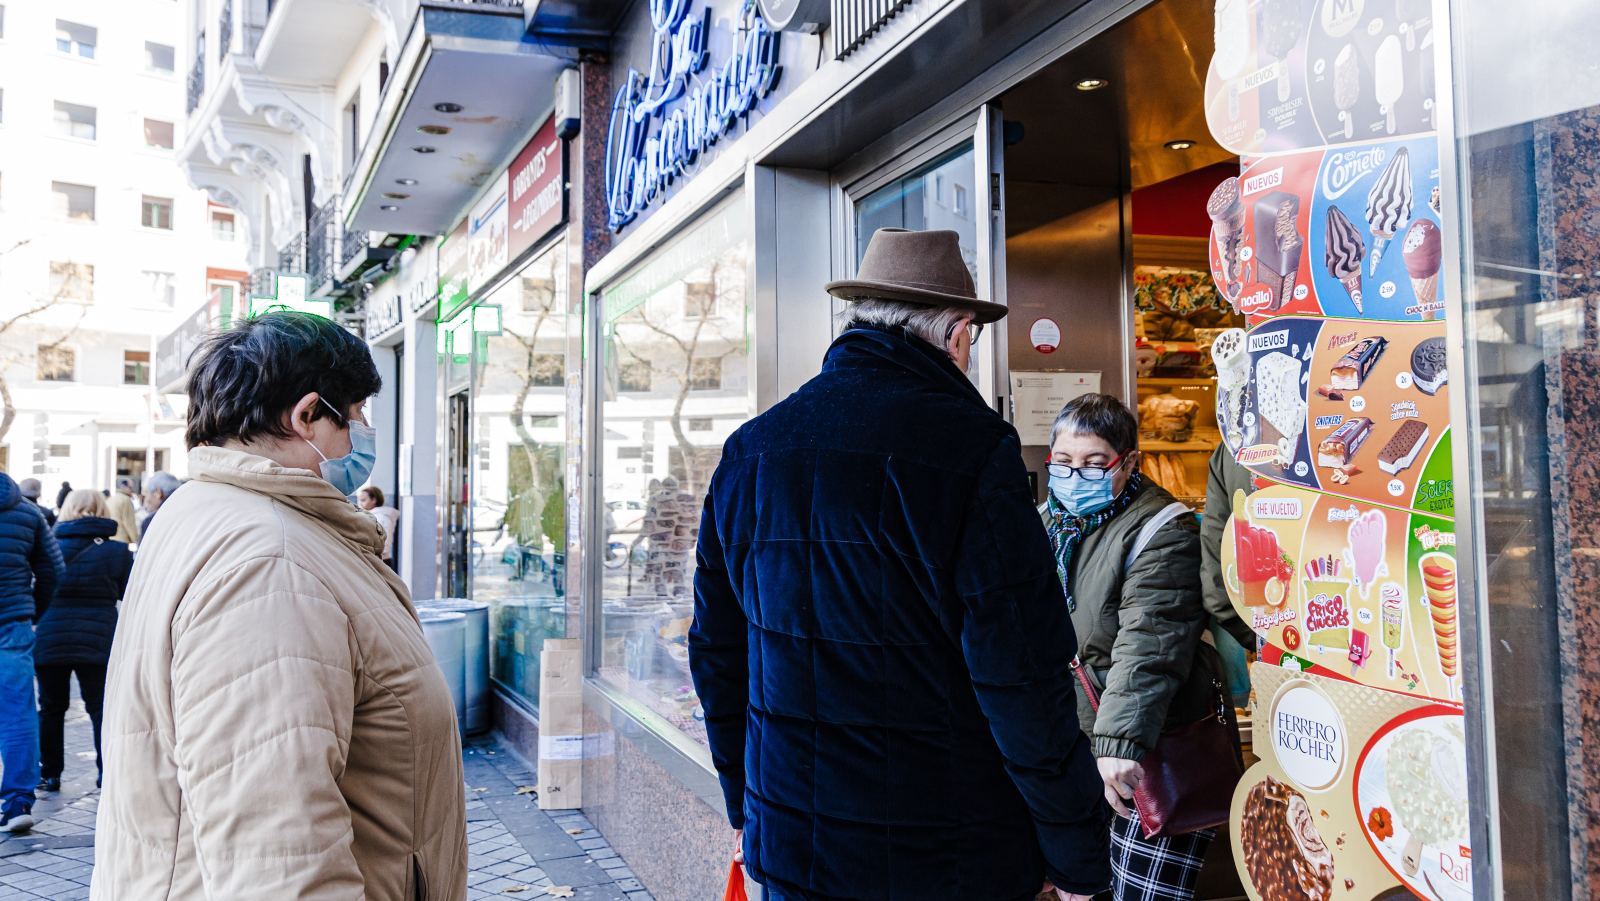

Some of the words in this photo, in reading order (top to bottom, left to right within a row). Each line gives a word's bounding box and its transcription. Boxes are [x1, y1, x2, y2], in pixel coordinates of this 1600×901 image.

[1328, 12, 1358, 30] MAGNUM
[1244, 66, 1274, 89] NUEVOS
[1274, 110, 1297, 123] DOUBLE
[1224, 129, 1245, 142] DOUBLE
[1322, 146, 1386, 201] Cornetto
[1247, 172, 1279, 193] NUEVOS
[1240, 290, 1270, 308] nocilla
[1406, 305, 1423, 315] CHOC
[1252, 333, 1285, 349] NUEVOS
[1327, 330, 1358, 350] Mars
[1315, 415, 1343, 426] SNICKERS
[1236, 447, 1278, 462] Filipinos
[1390, 483, 1402, 491] 1,50€
[1257, 502, 1268, 515] ¡HE
[1270, 502, 1298, 516] VUELTO!
[1429, 497, 1454, 511] EXOTIC
[1308, 595, 1343, 618] FRIGO
[1306, 607, 1349, 632] CHUCHES
[1359, 610, 1370, 620] 1,50€
[1286, 630, 1296, 645] 1€
[1278, 711, 1337, 744] FERRERO
[1278, 729, 1337, 764] ROCHER
